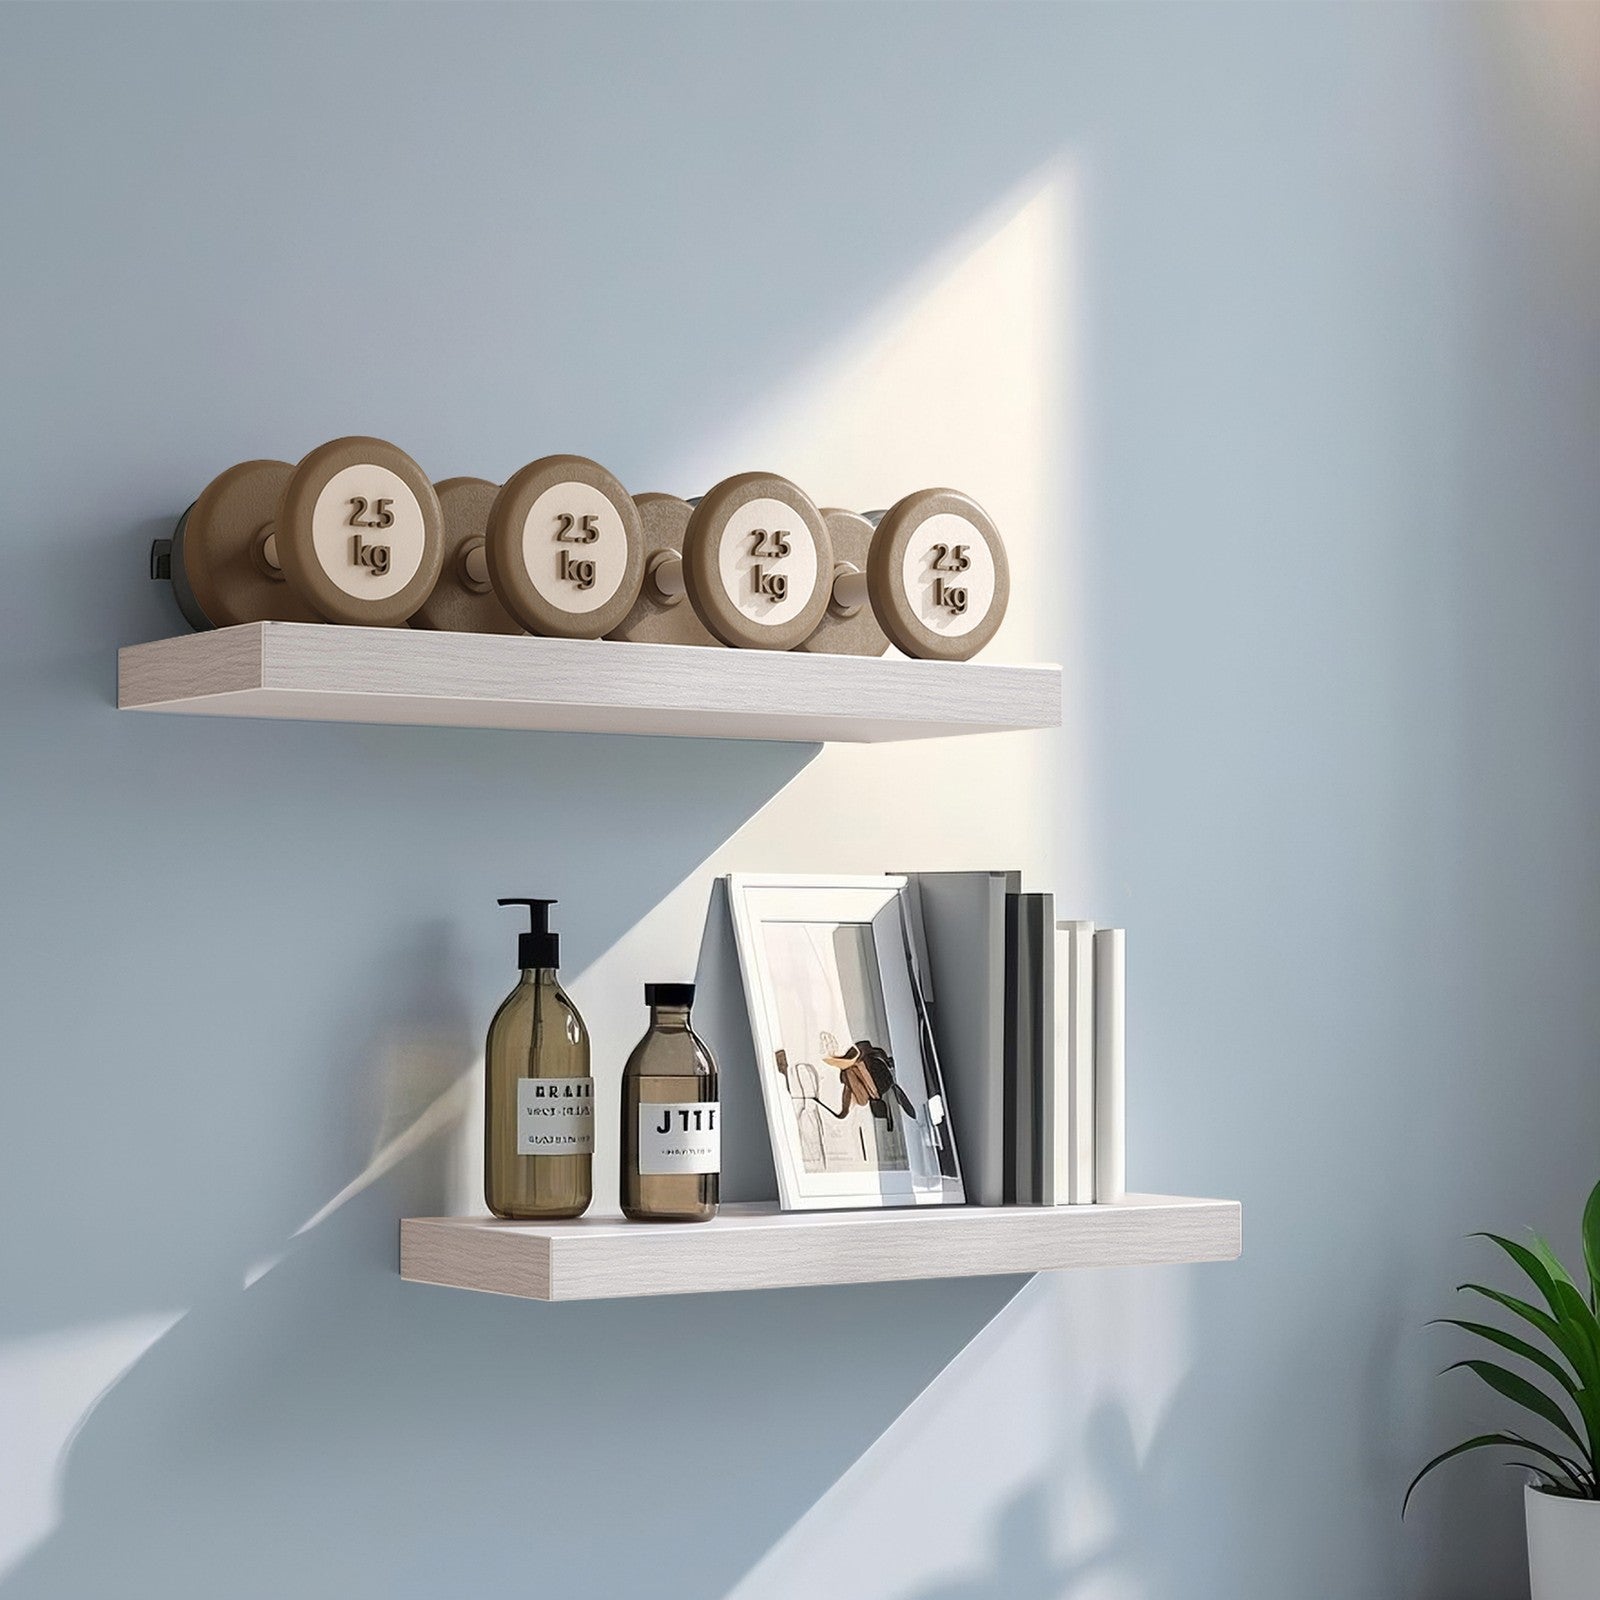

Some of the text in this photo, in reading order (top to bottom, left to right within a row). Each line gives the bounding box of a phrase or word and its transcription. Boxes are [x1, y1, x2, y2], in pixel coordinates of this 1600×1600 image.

[349, 497, 395, 529] 2.5
[556, 513, 600, 544] 2.5
[353, 534, 391, 577] kg
[750, 529, 791, 558] 2.5
[931, 543, 971, 572] 2.5
[560, 550, 596, 590] kg
[752, 564, 788, 603] kg
[934, 578, 968, 615] kg
